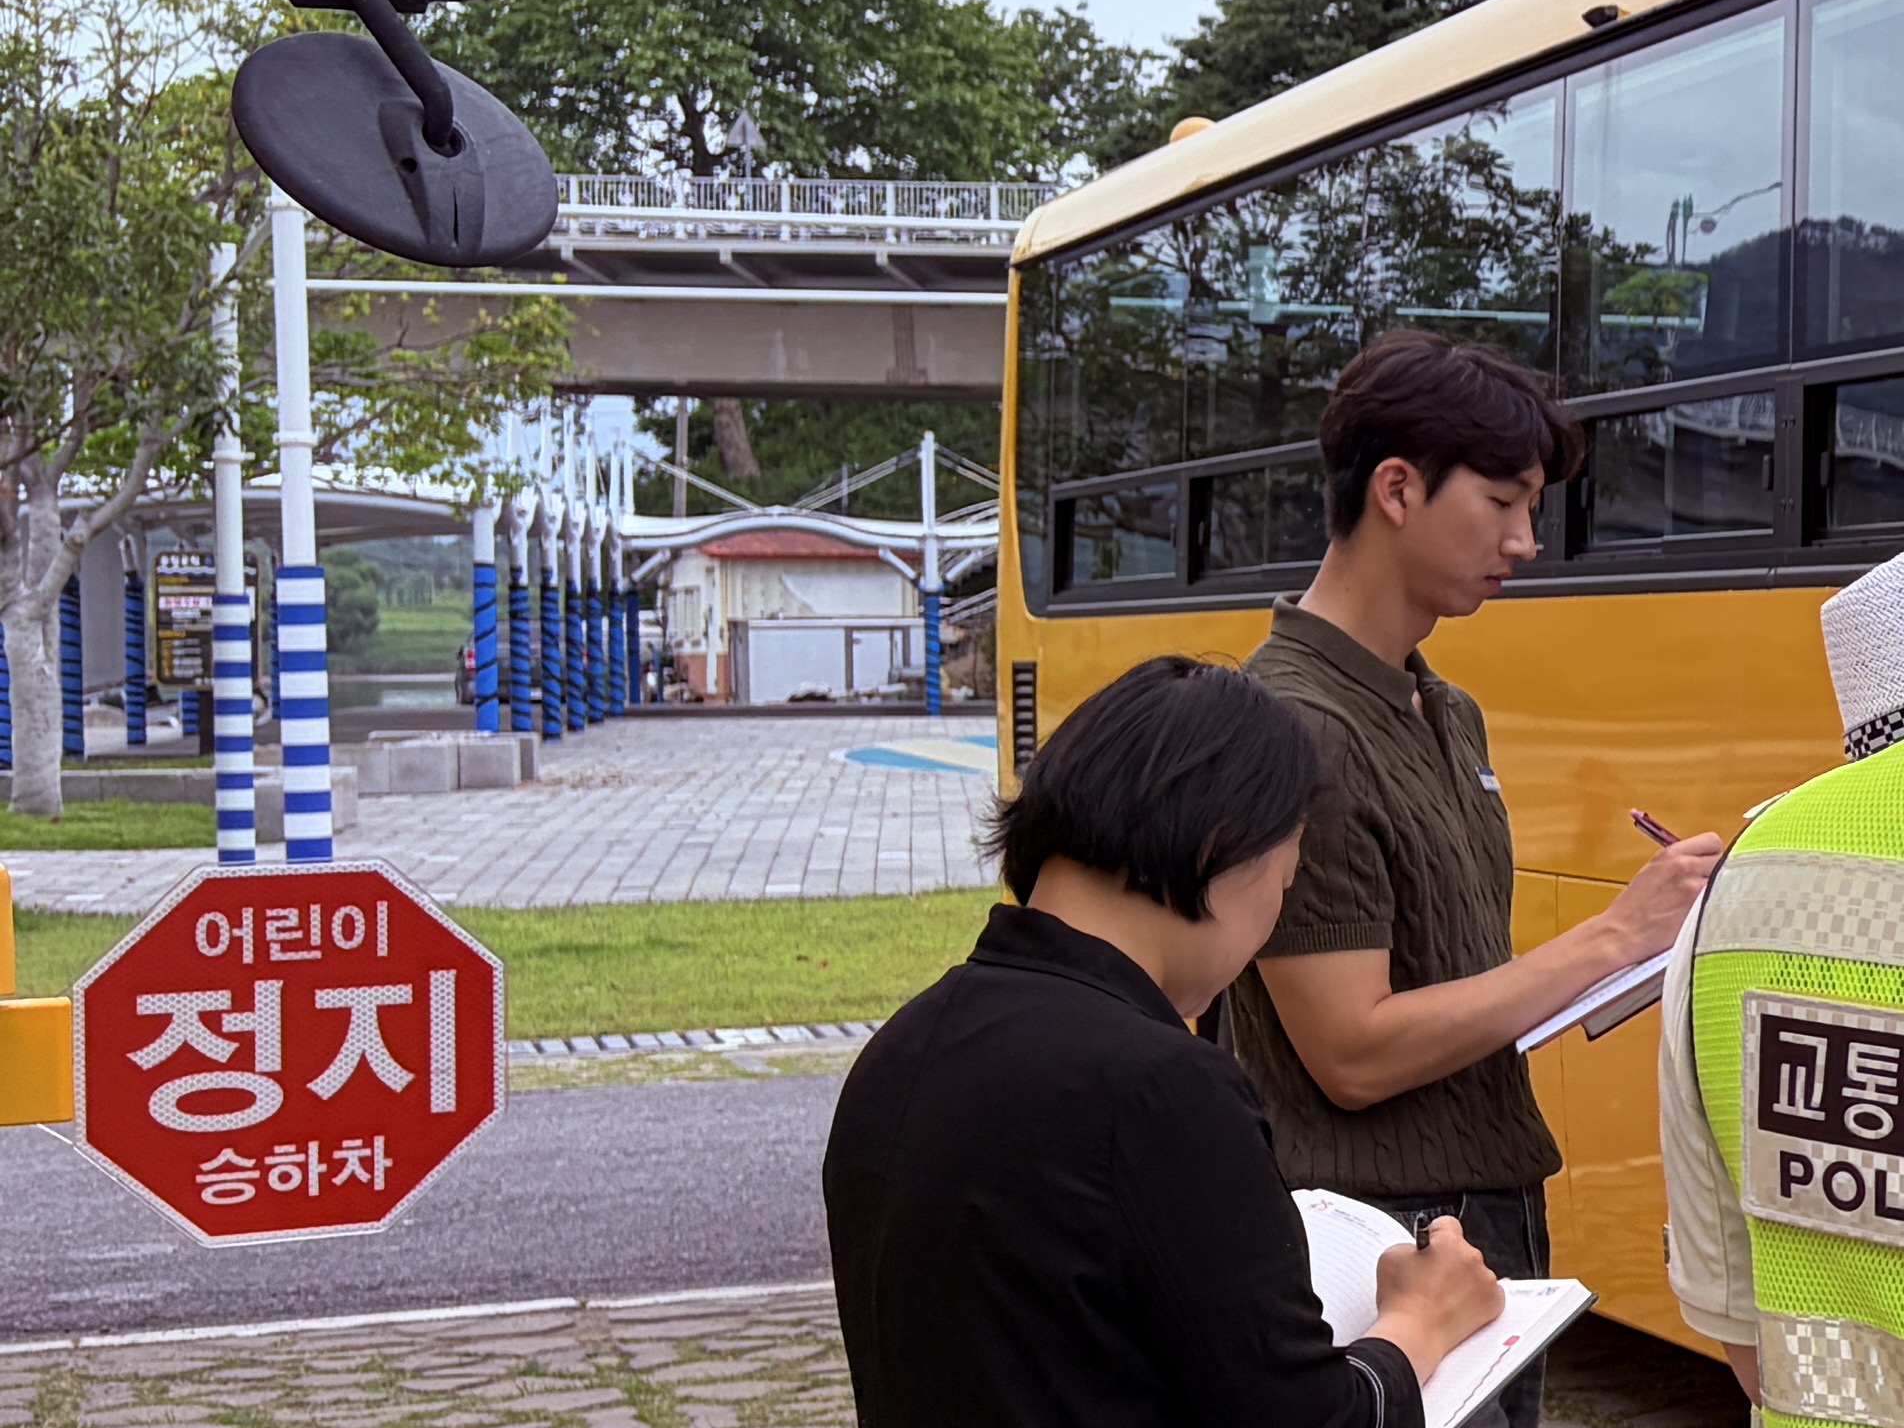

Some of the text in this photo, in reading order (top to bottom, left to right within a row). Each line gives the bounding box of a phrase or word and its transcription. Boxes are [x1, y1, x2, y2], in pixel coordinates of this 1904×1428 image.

[194, 900, 389, 964] 어린이
[126, 969, 457, 1133] 정지
[195, 1135, 393, 1206] 승하차
